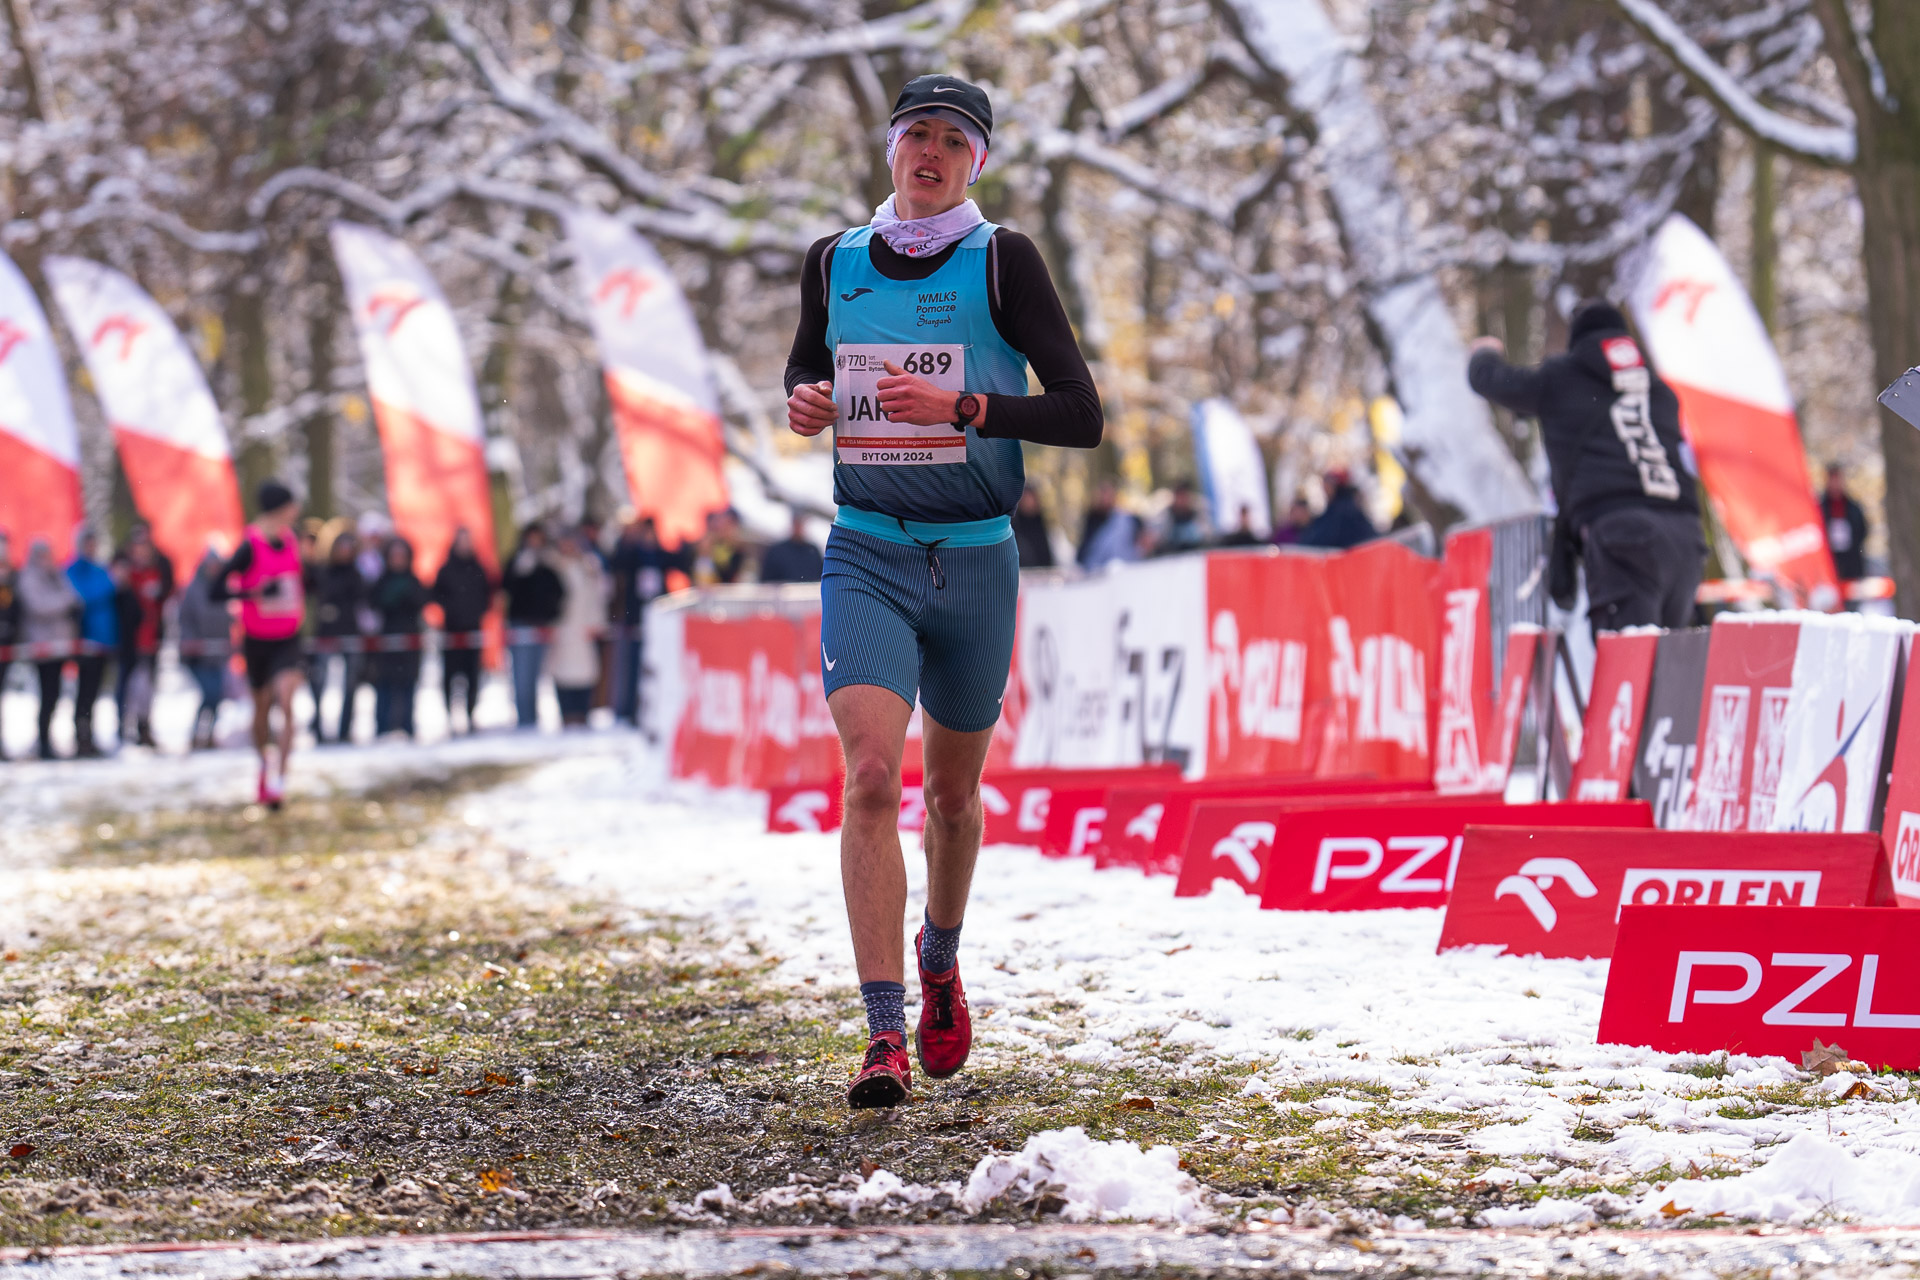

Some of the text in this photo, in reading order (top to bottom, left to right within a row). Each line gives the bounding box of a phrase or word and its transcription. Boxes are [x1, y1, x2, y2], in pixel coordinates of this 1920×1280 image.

[918, 291, 957, 303] WMLKS
[916, 304, 956, 313] Pomorze
[917, 314, 952, 327] Stargard
[848, 352, 952, 374] 770 689
[861, 452, 933, 461] BYTOM 2024
